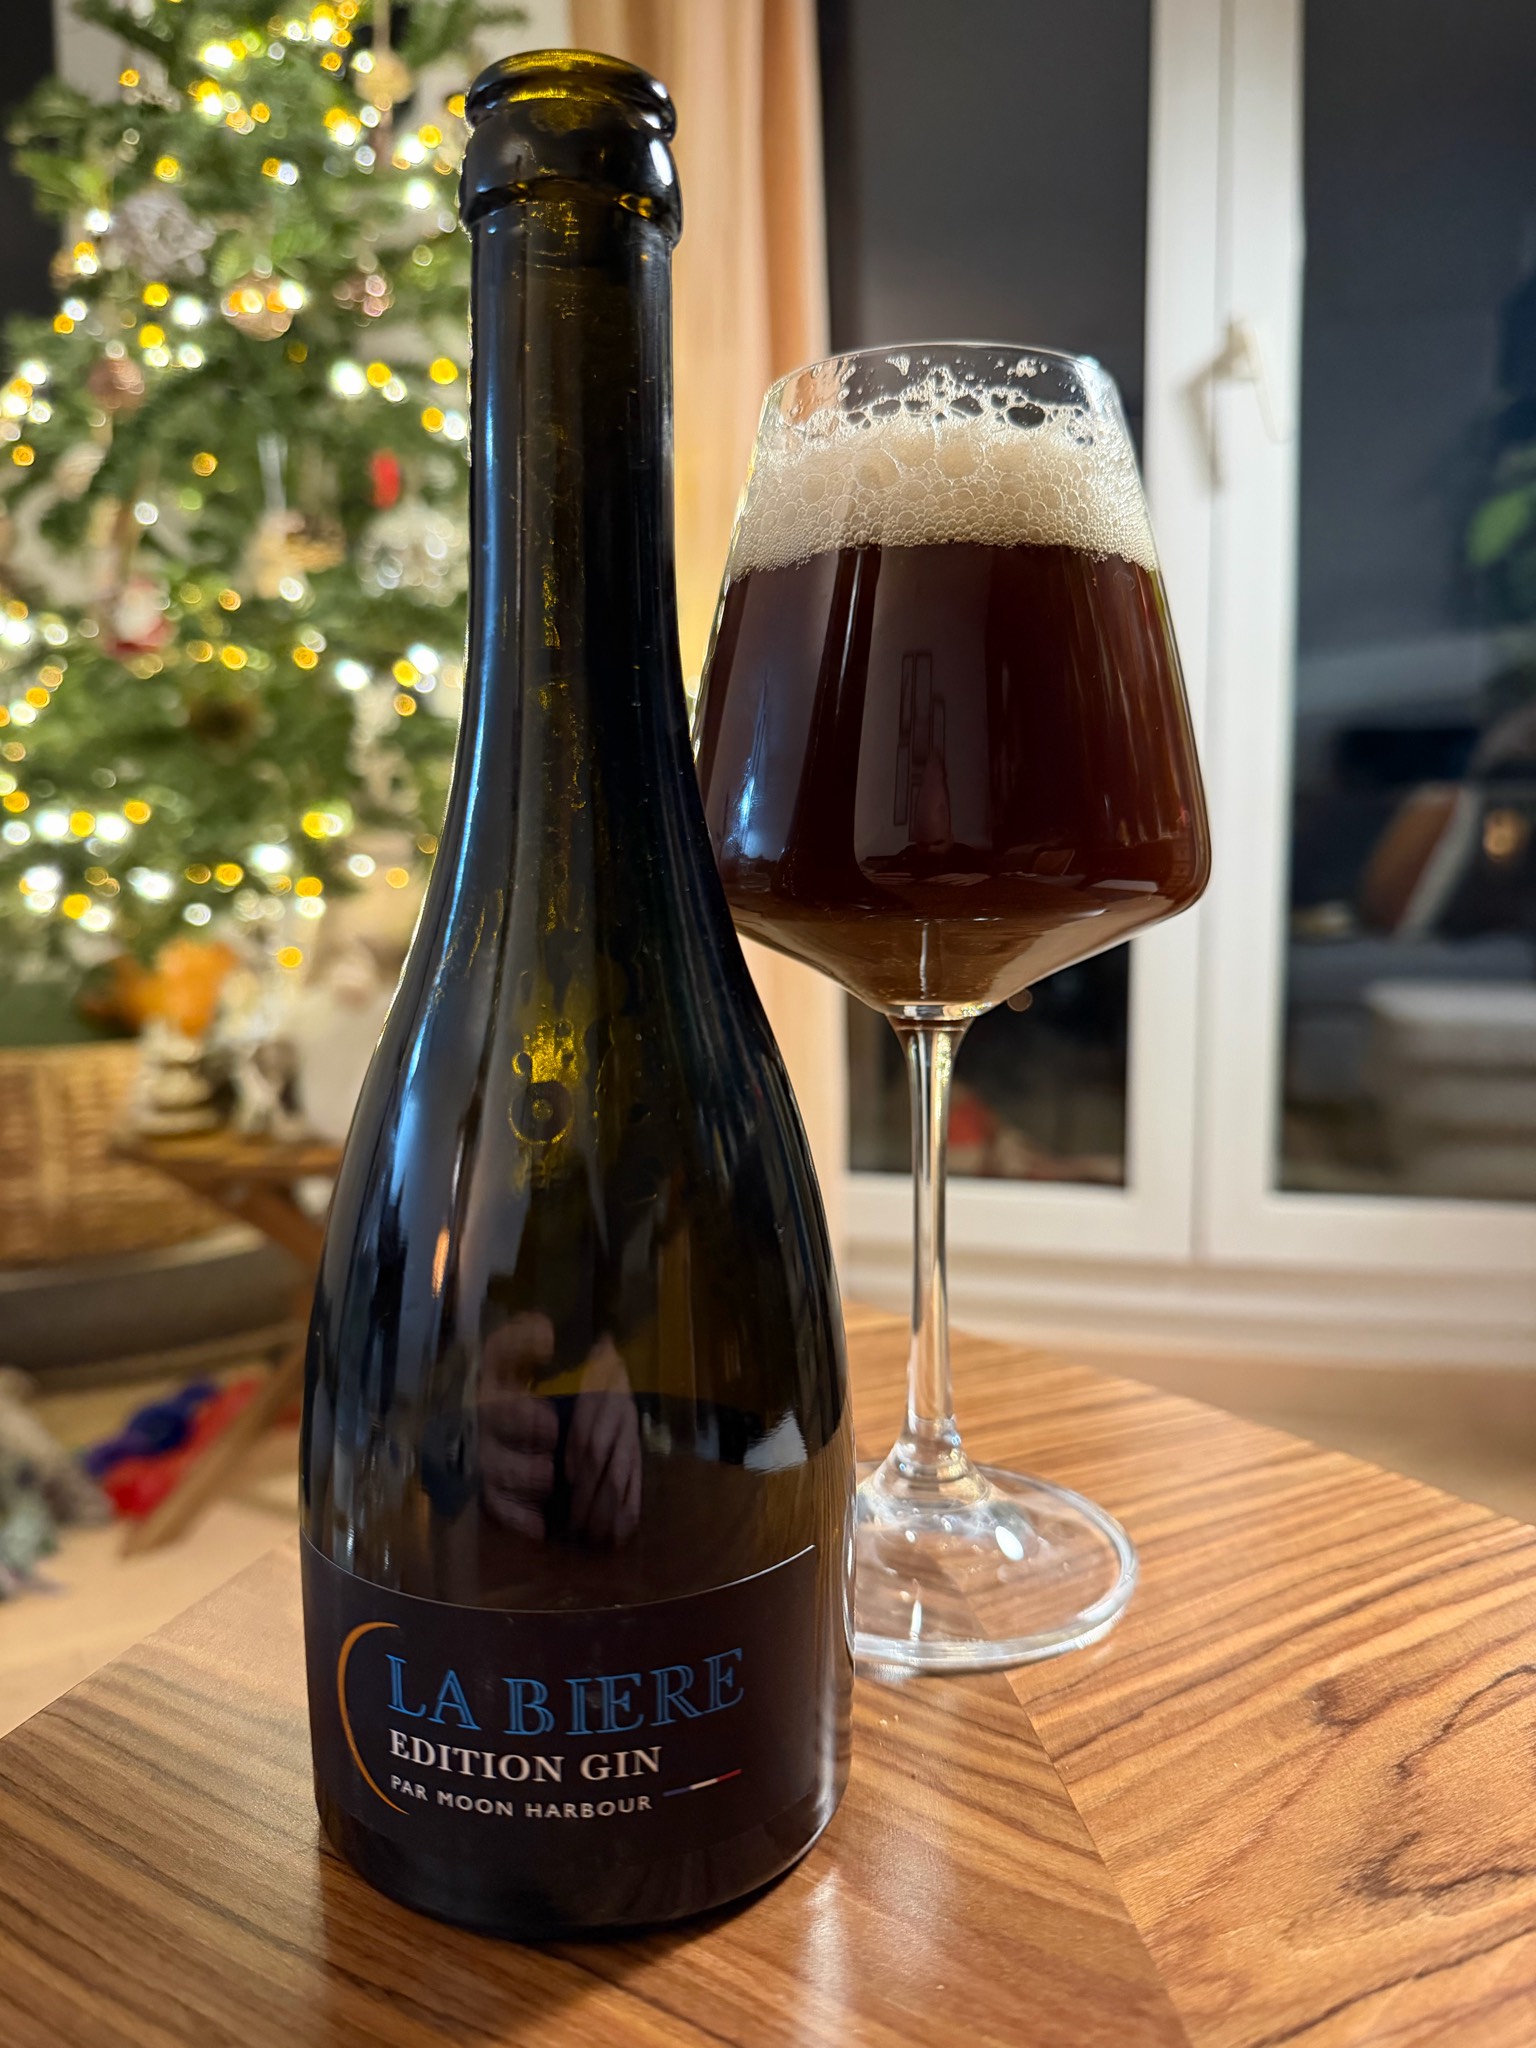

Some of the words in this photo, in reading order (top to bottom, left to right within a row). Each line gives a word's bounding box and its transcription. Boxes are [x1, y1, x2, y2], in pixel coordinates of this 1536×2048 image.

[385, 1654, 482, 1731] LA
[502, 1648, 744, 1736] BIERE
[388, 1728, 563, 1782] EDITION
[580, 1747, 663, 1781] GIN
[390, 1775, 428, 1801] PAR
[437, 1792, 514, 1817] MOON
[525, 1796, 652, 1819] HARBOUR
